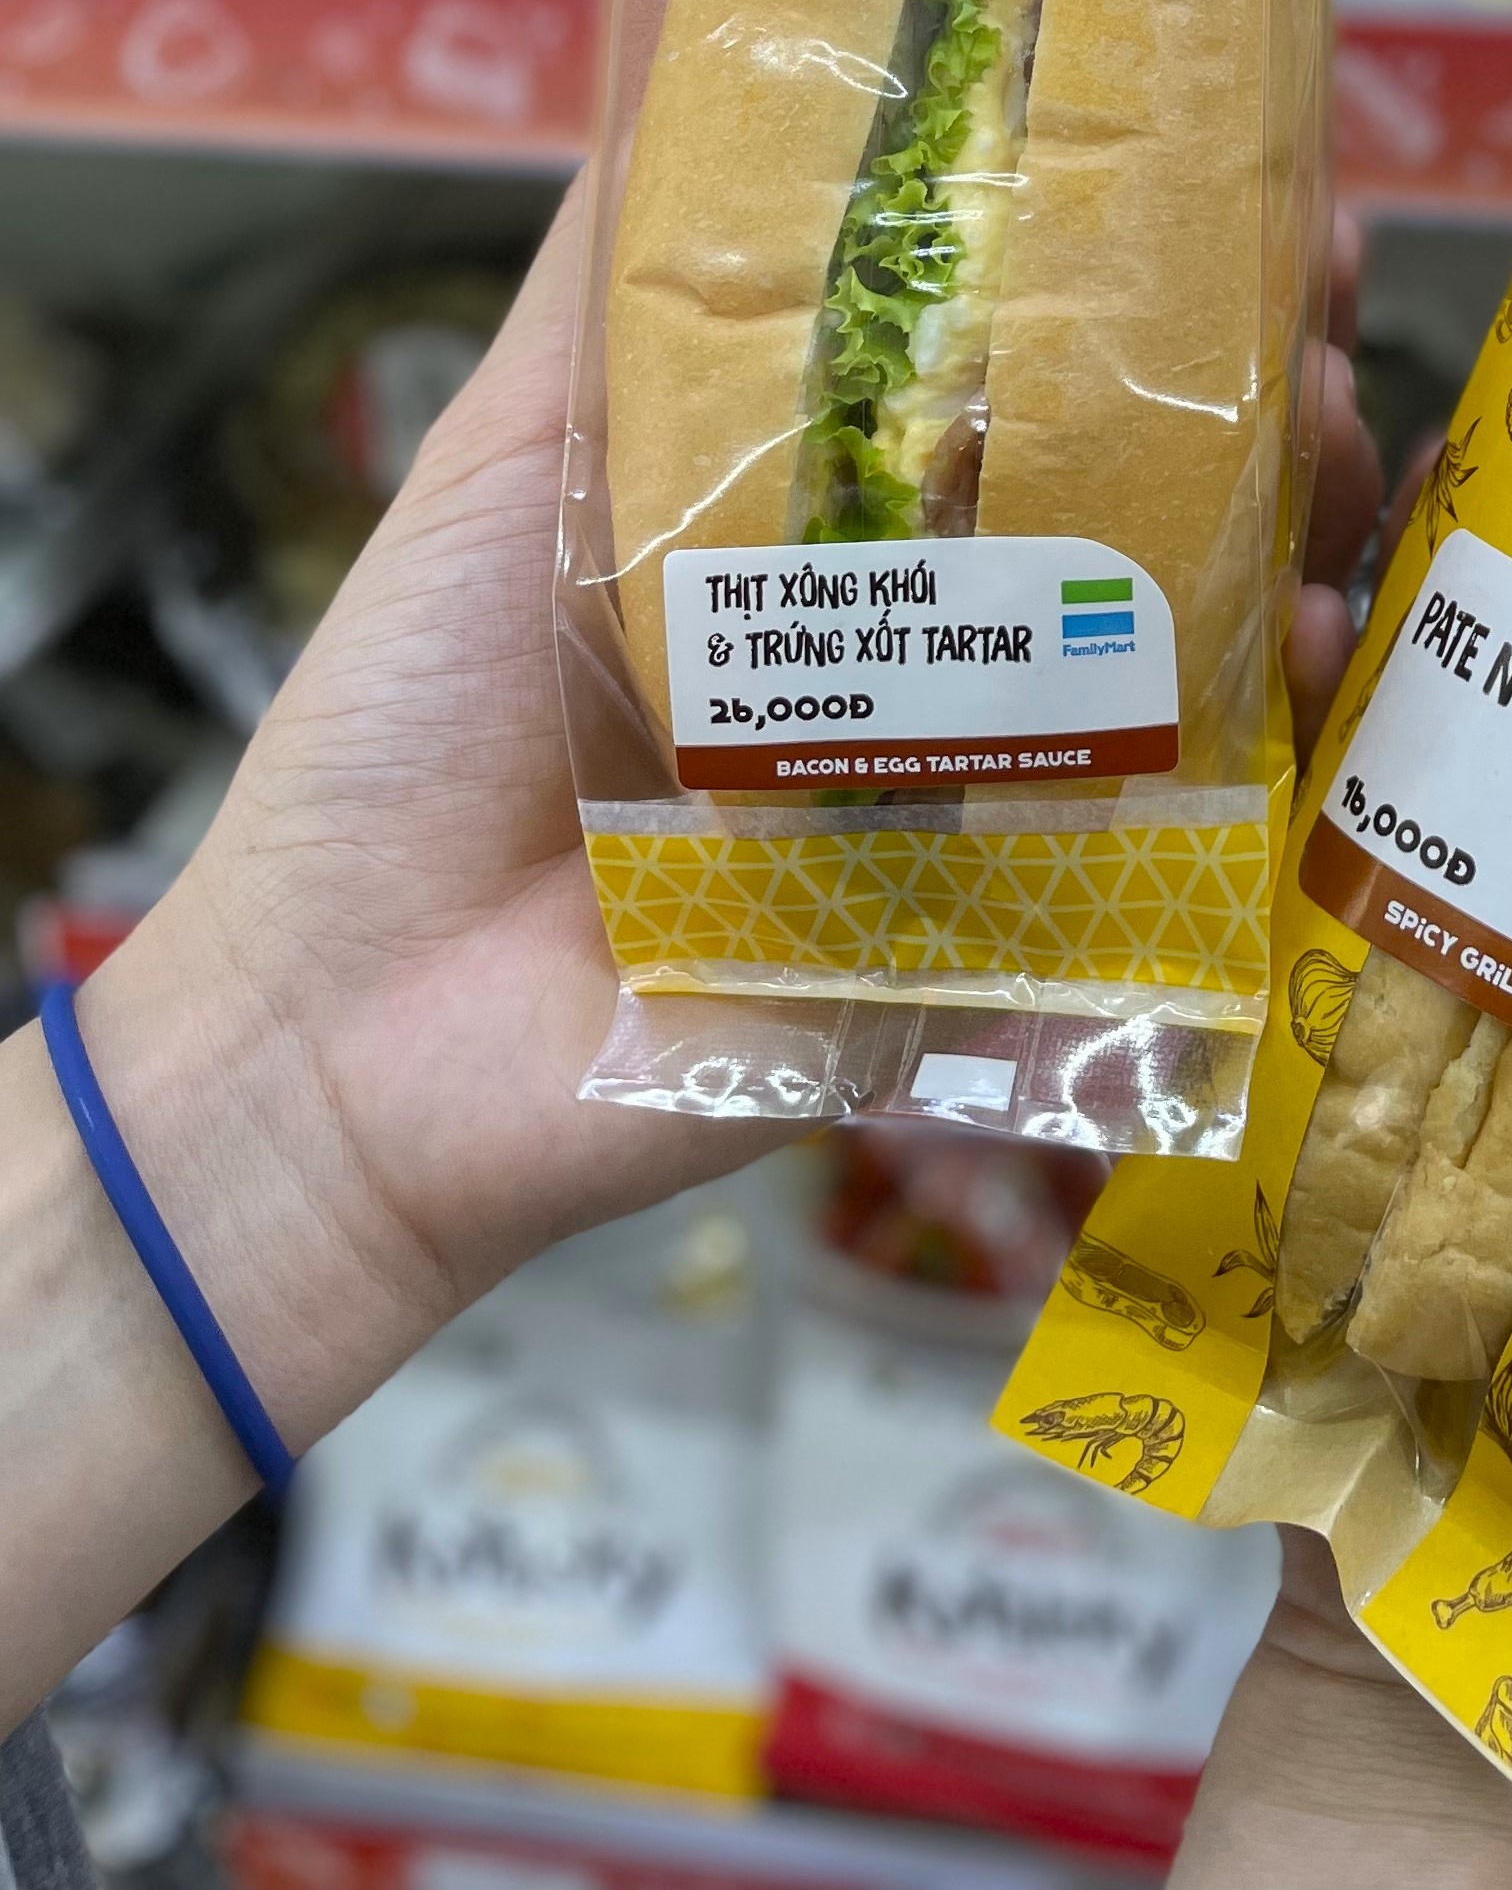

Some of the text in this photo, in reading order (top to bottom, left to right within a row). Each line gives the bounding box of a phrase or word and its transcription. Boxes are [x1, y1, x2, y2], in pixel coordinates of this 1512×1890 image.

[705, 559, 937, 620] THỊT XÔNG KHÓI
[707, 609, 1032, 669] & TRỨNG XỐT TARTAR
[1062, 639, 1136, 657] FamilyMart
[1412, 591, 1491, 682] PATE
[709, 693, 875, 731] 26,000Đ
[776, 748, 1091, 777] BACON & EGG TARTAR SAUCE
[1341, 774, 1476, 886] 16,000Đ
